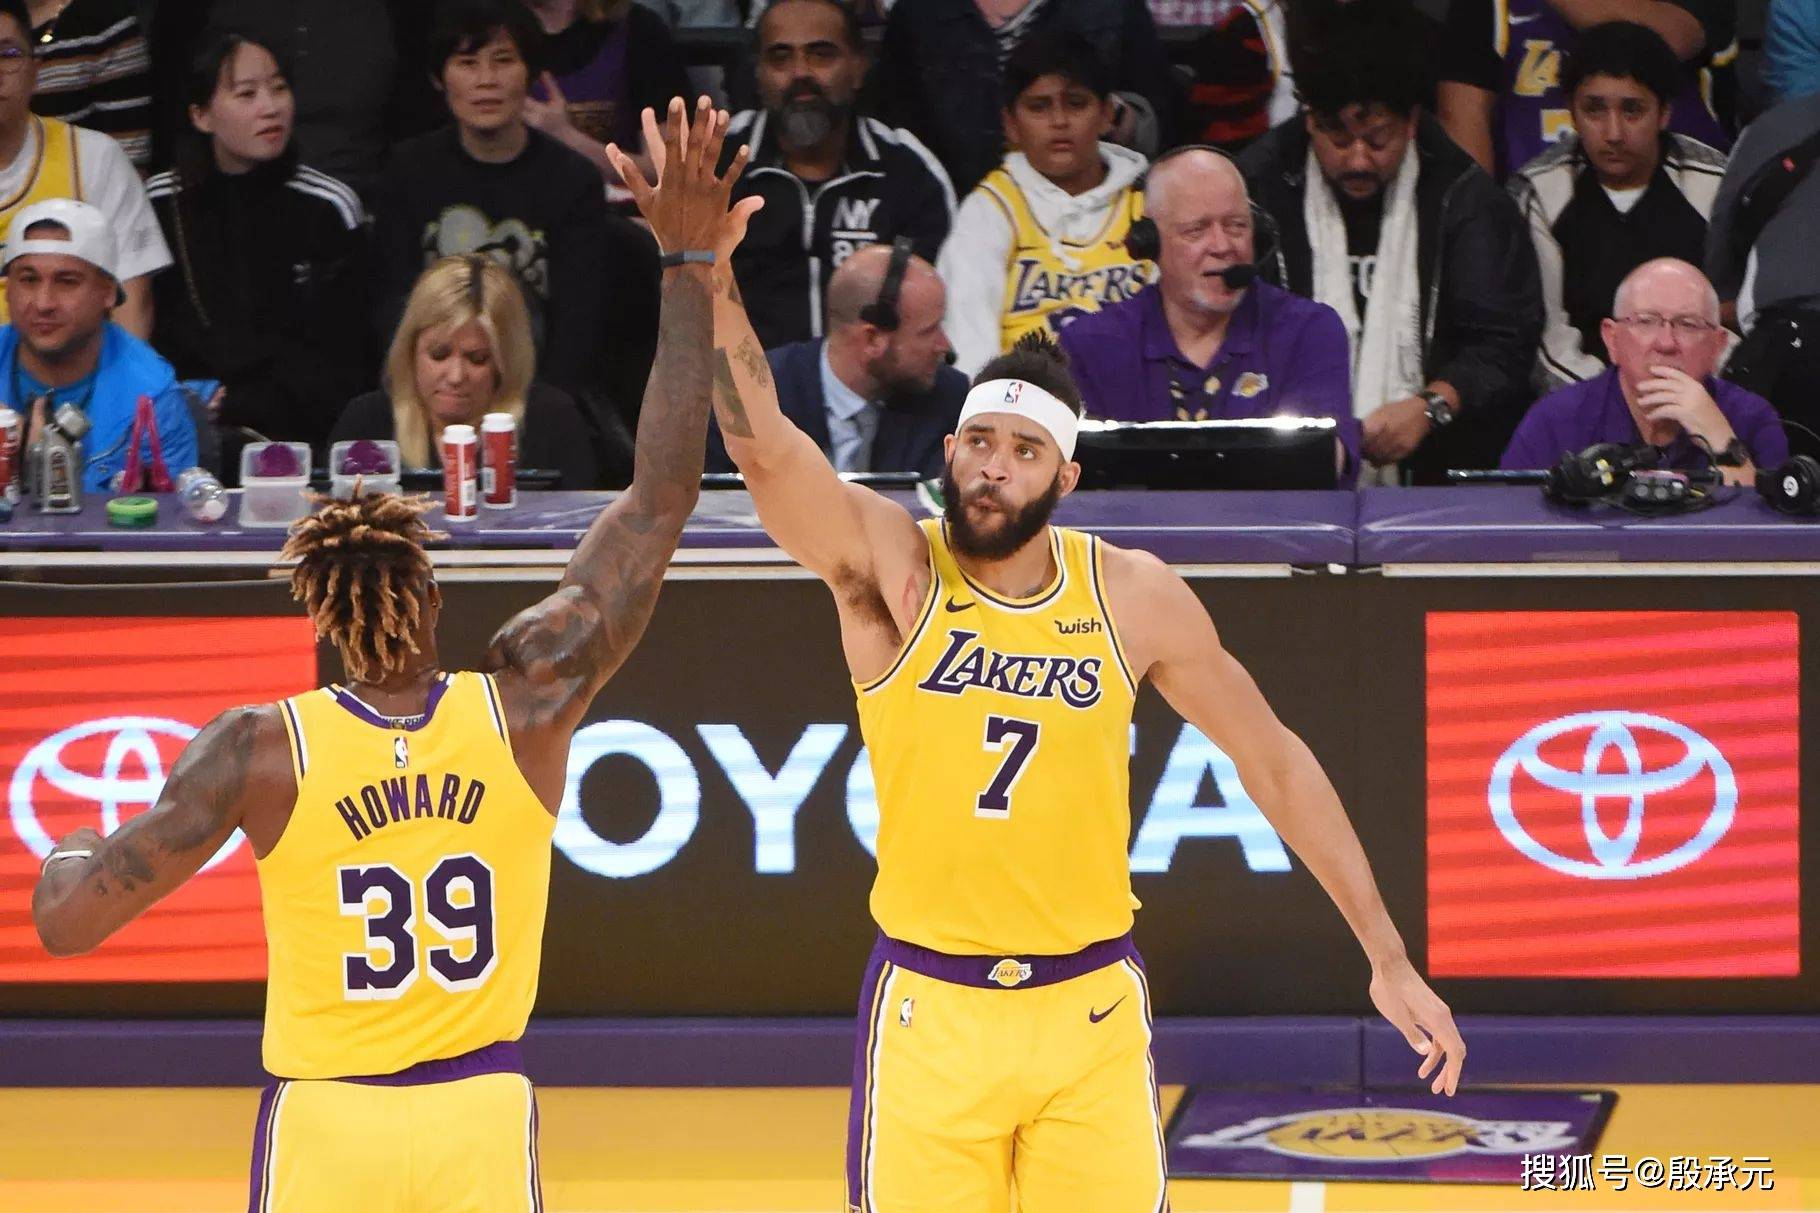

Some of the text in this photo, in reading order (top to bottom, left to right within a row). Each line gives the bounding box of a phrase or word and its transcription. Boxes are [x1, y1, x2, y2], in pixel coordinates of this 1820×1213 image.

[832, 196, 881, 229] NY
[1054, 617, 1101, 635] wish
[917, 629, 1103, 710] LAKERS
[974, 713, 1042, 820] 7
[335, 773, 486, 842] HOWARD
[336, 851, 499, 1002] 39
